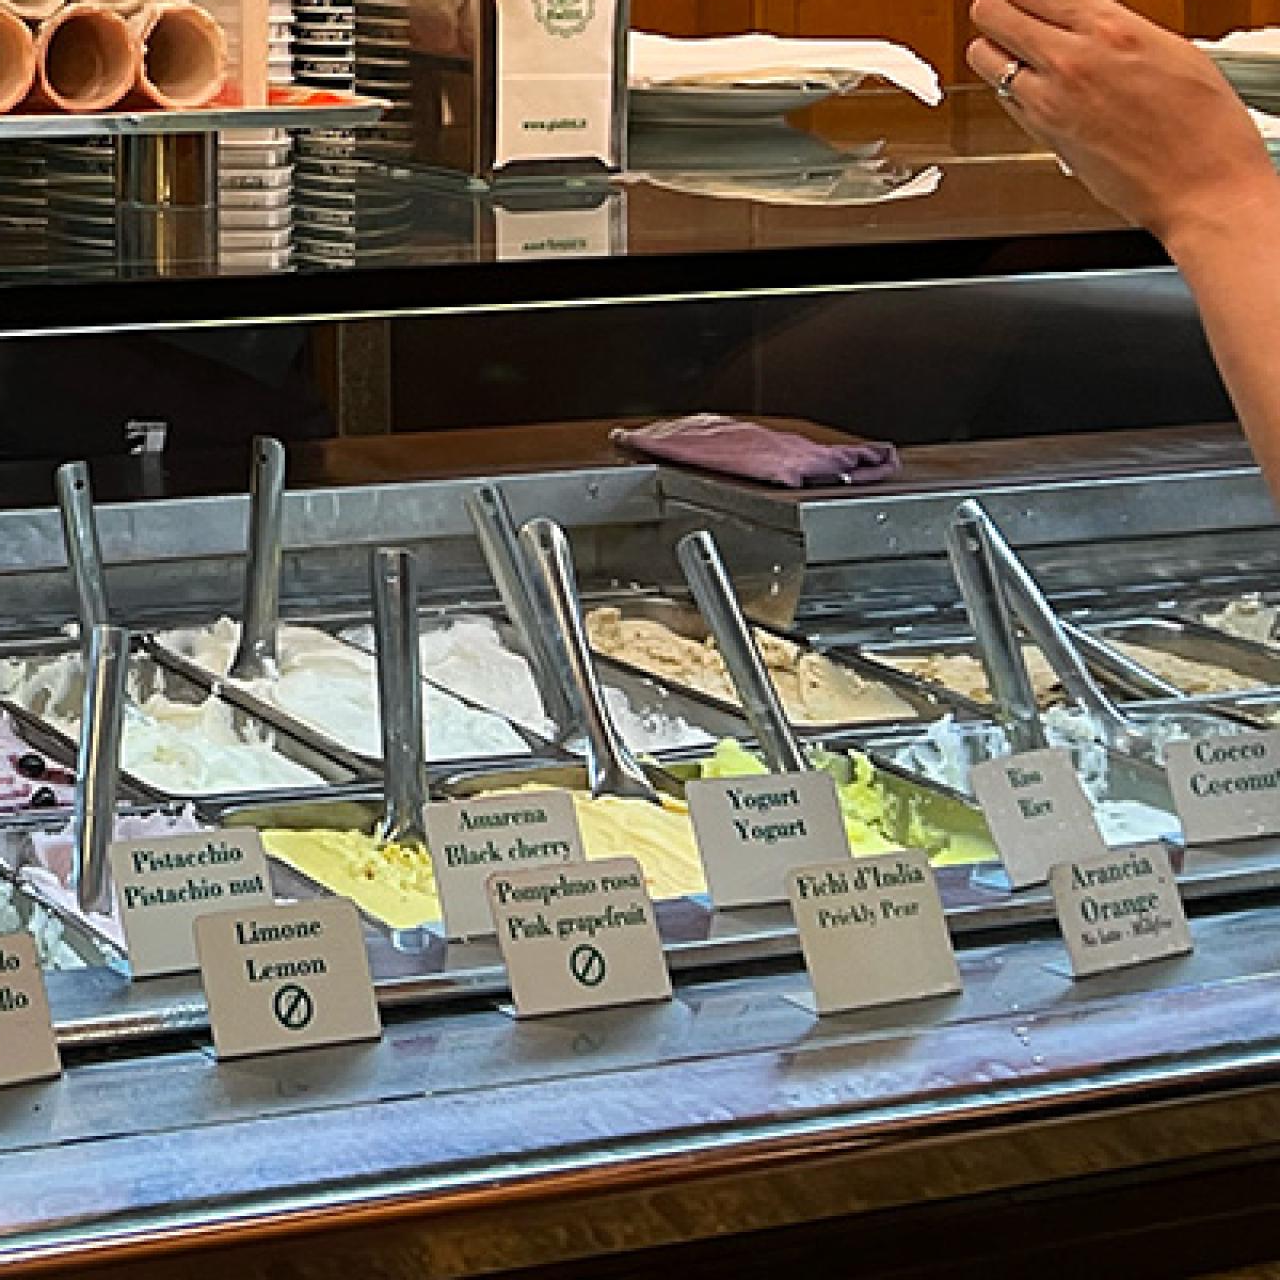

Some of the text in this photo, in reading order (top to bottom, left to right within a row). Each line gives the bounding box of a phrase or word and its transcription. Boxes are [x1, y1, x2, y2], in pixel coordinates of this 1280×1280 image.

[1194, 739, 1266, 765] Cocco
[726, 789, 800, 813] Yogurt
[458, 807, 548, 833] Amarena
[733, 820, 807, 845] Yogurt
[131, 841, 243, 874] Pistacchio
[443, 837, 572, 868] Black cherry
[1071, 851, 1152, 890] Arancia
[124, 873, 263, 909] Pistachio nut
[495, 873, 642, 906] Pompelmo rosa
[797, 871, 849, 899] Fichi
[506, 903, 647, 939] Pink grapefruit
[819, 900, 919, 928] Prickly Pear
[1081, 893, 1159, 924] Orange
[235, 918, 321, 946] Limone
[246, 955, 327, 983] Lemon
